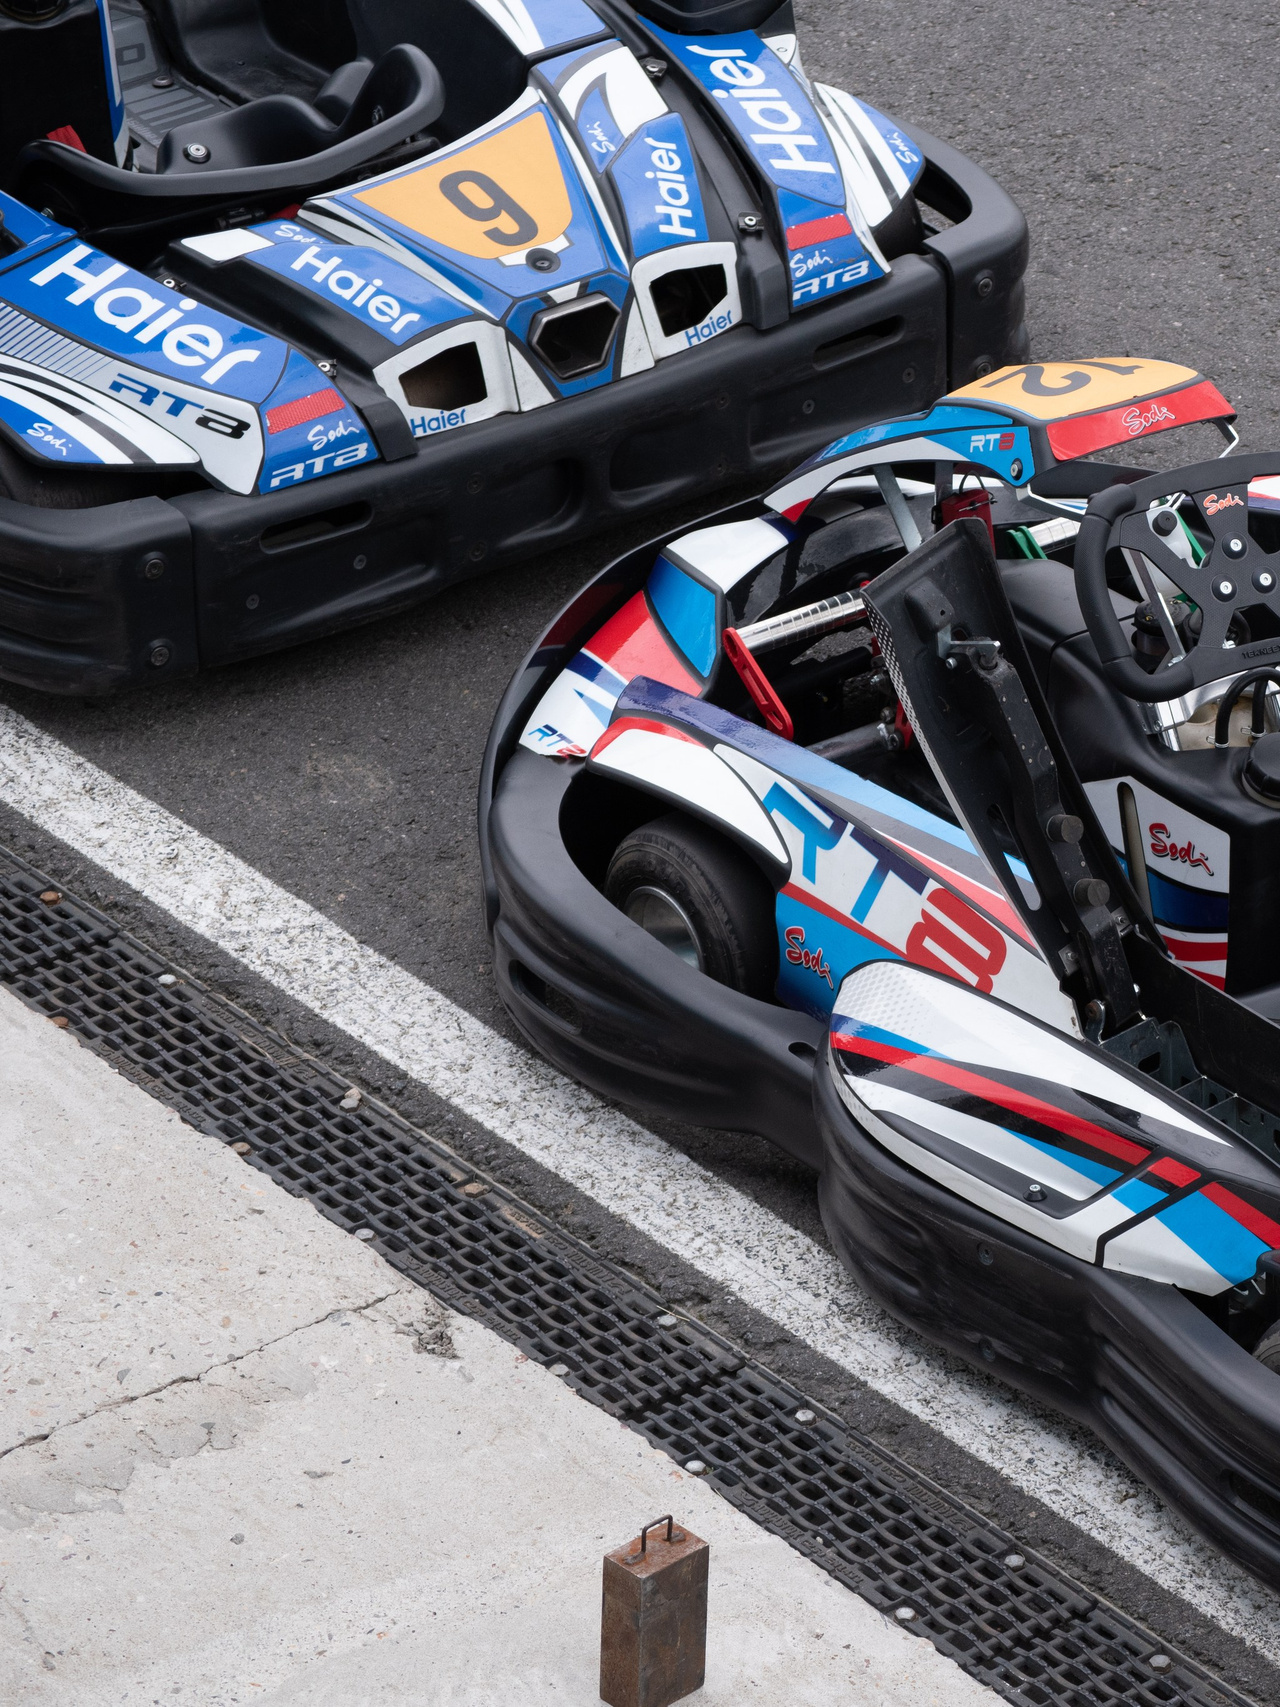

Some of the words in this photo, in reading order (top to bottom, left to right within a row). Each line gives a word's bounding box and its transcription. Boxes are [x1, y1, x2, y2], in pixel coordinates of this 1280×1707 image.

[686, 44, 836, 175] Haier
[438, 170, 539, 247] 9
[643, 136, 696, 238] Haier
[789, 248, 833, 278] Sodi
[792, 260, 870, 301] RT8
[290, 244, 421, 335] Haier
[28, 242, 262, 386] Haier
[684, 309, 734, 347] Haier
[978, 360, 1144, 397] 12
[109, 373, 251, 440] RT8
[409, 407, 466, 437] Haier
[1120, 405, 1176, 436] Sodi
[306, 418, 361, 452] Sodi
[969, 431, 1016, 453] RT8
[269, 442, 369, 489] RT8
[1202, 492, 1245, 517] Sodi
[1148, 821, 1214, 877] Sodi
[785, 926, 835, 991] Sodi
